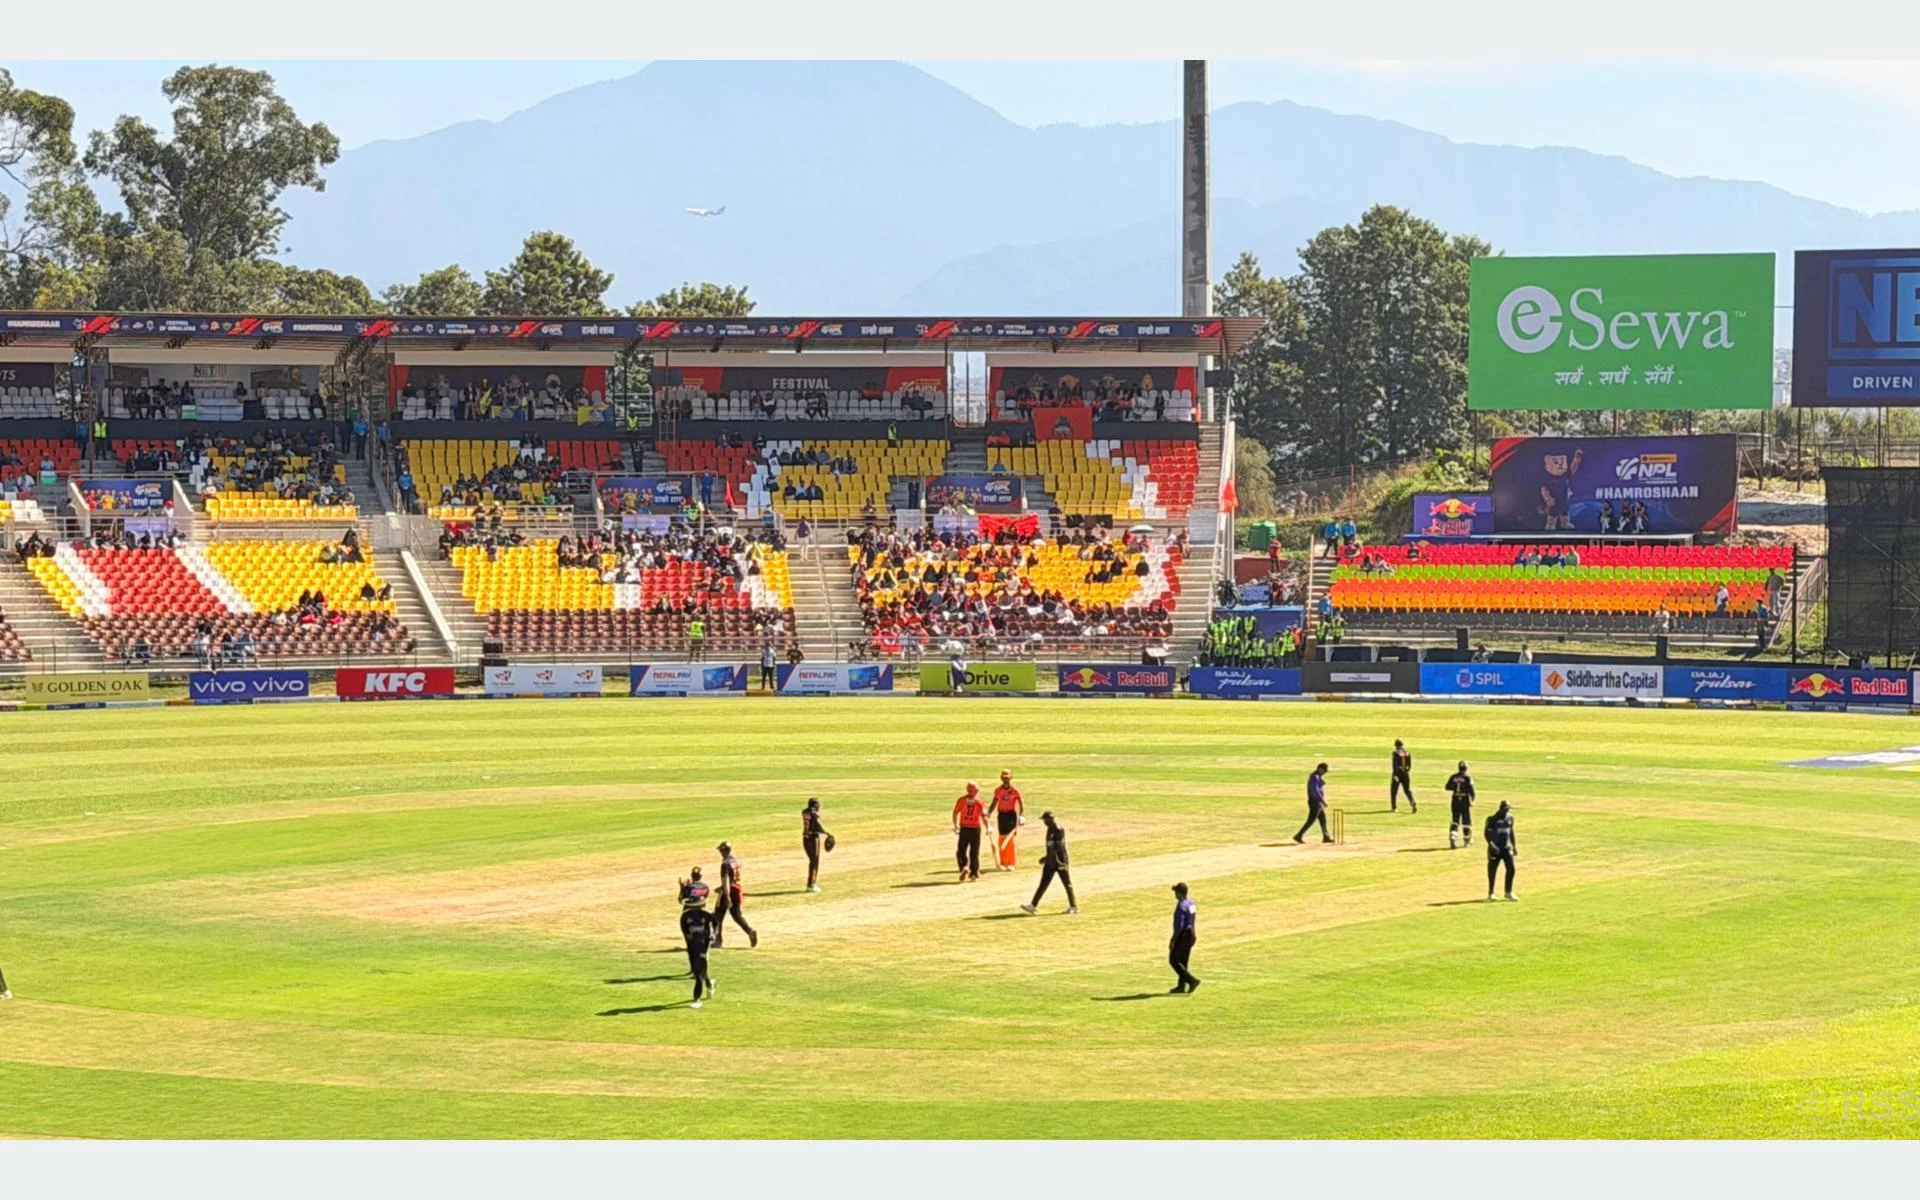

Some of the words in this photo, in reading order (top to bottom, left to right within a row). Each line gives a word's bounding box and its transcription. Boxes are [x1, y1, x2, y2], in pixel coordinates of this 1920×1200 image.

[1498, 286, 1735, 353] eSewa
[0, 369, 16, 381] TS
[1852, 376, 1913, 389] DRIVEN
[772, 378, 831, 389] FESTIVAL
[1638, 463, 1677, 478] NPL
[1595, 486, 1699, 499] #HAMROSHAAN
[47, 681, 106, 693] GOLDEN
[111, 680, 142, 691] OAK
[194, 678, 246, 693] vivo
[253, 676, 304, 692] vivo
[364, 671, 425, 692] KFC
[1118, 671, 1141, 687] Red
[1143, 671, 1168, 687] Bull
[1475, 672, 1504, 686] SPIL
[1566, 670, 1621, 688] Siddhartha
[1622, 670, 1658, 693] Capital
[1851, 677, 1879, 695] Red
[1879, 677, 1908, 695] Bull
